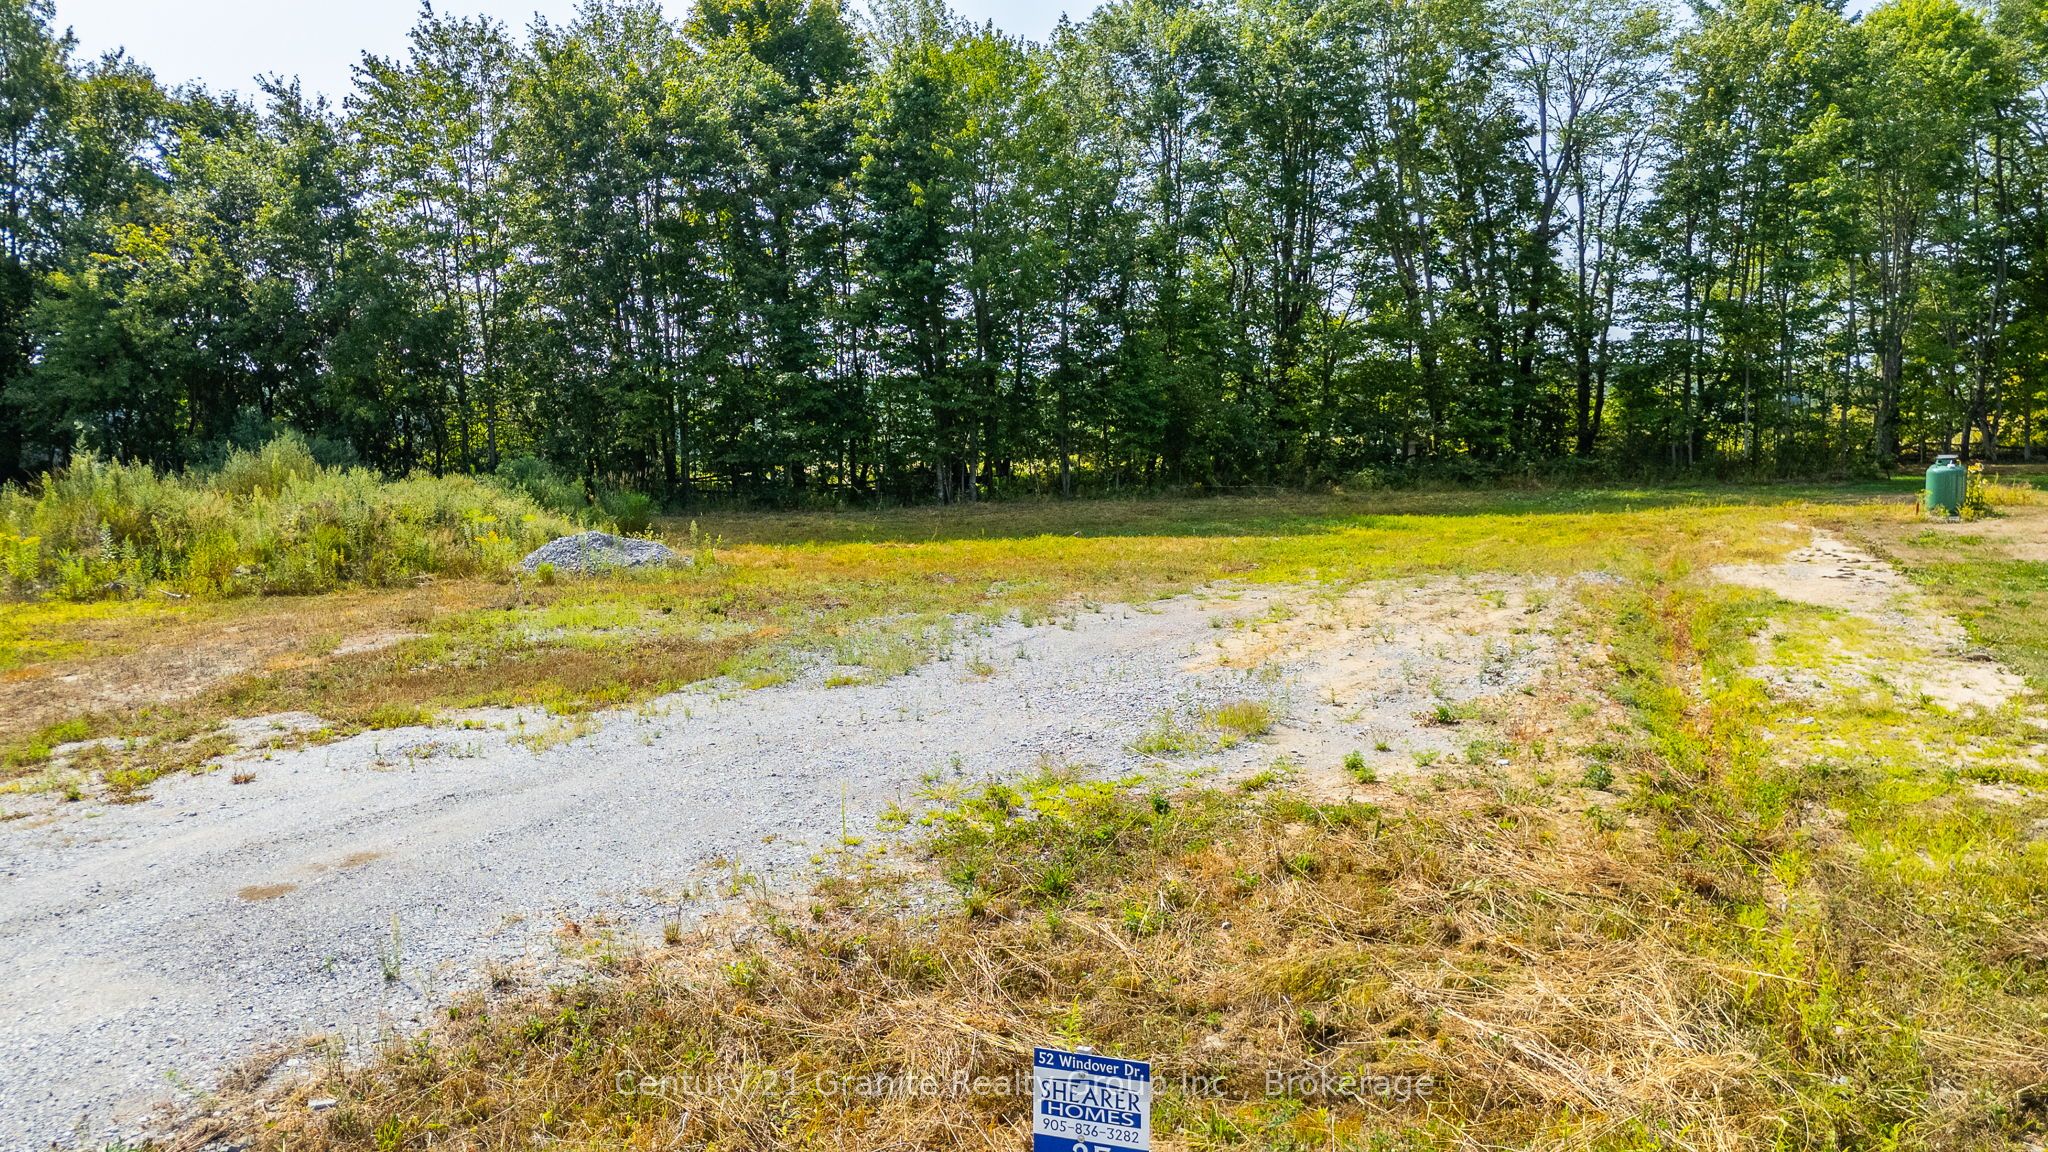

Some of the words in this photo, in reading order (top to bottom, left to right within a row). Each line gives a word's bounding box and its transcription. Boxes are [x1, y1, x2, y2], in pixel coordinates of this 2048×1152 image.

[1038, 1051, 1054, 1066] 52
[1059, 1054, 1119, 1075] Windover
[1124, 1063, 1144, 1078] Dr.
[1041, 1080, 1141, 1113] SHEARER
[1047, 1101, 1135, 1127] HOMES
[1042, 1118, 1140, 1144] 905-836-3282
